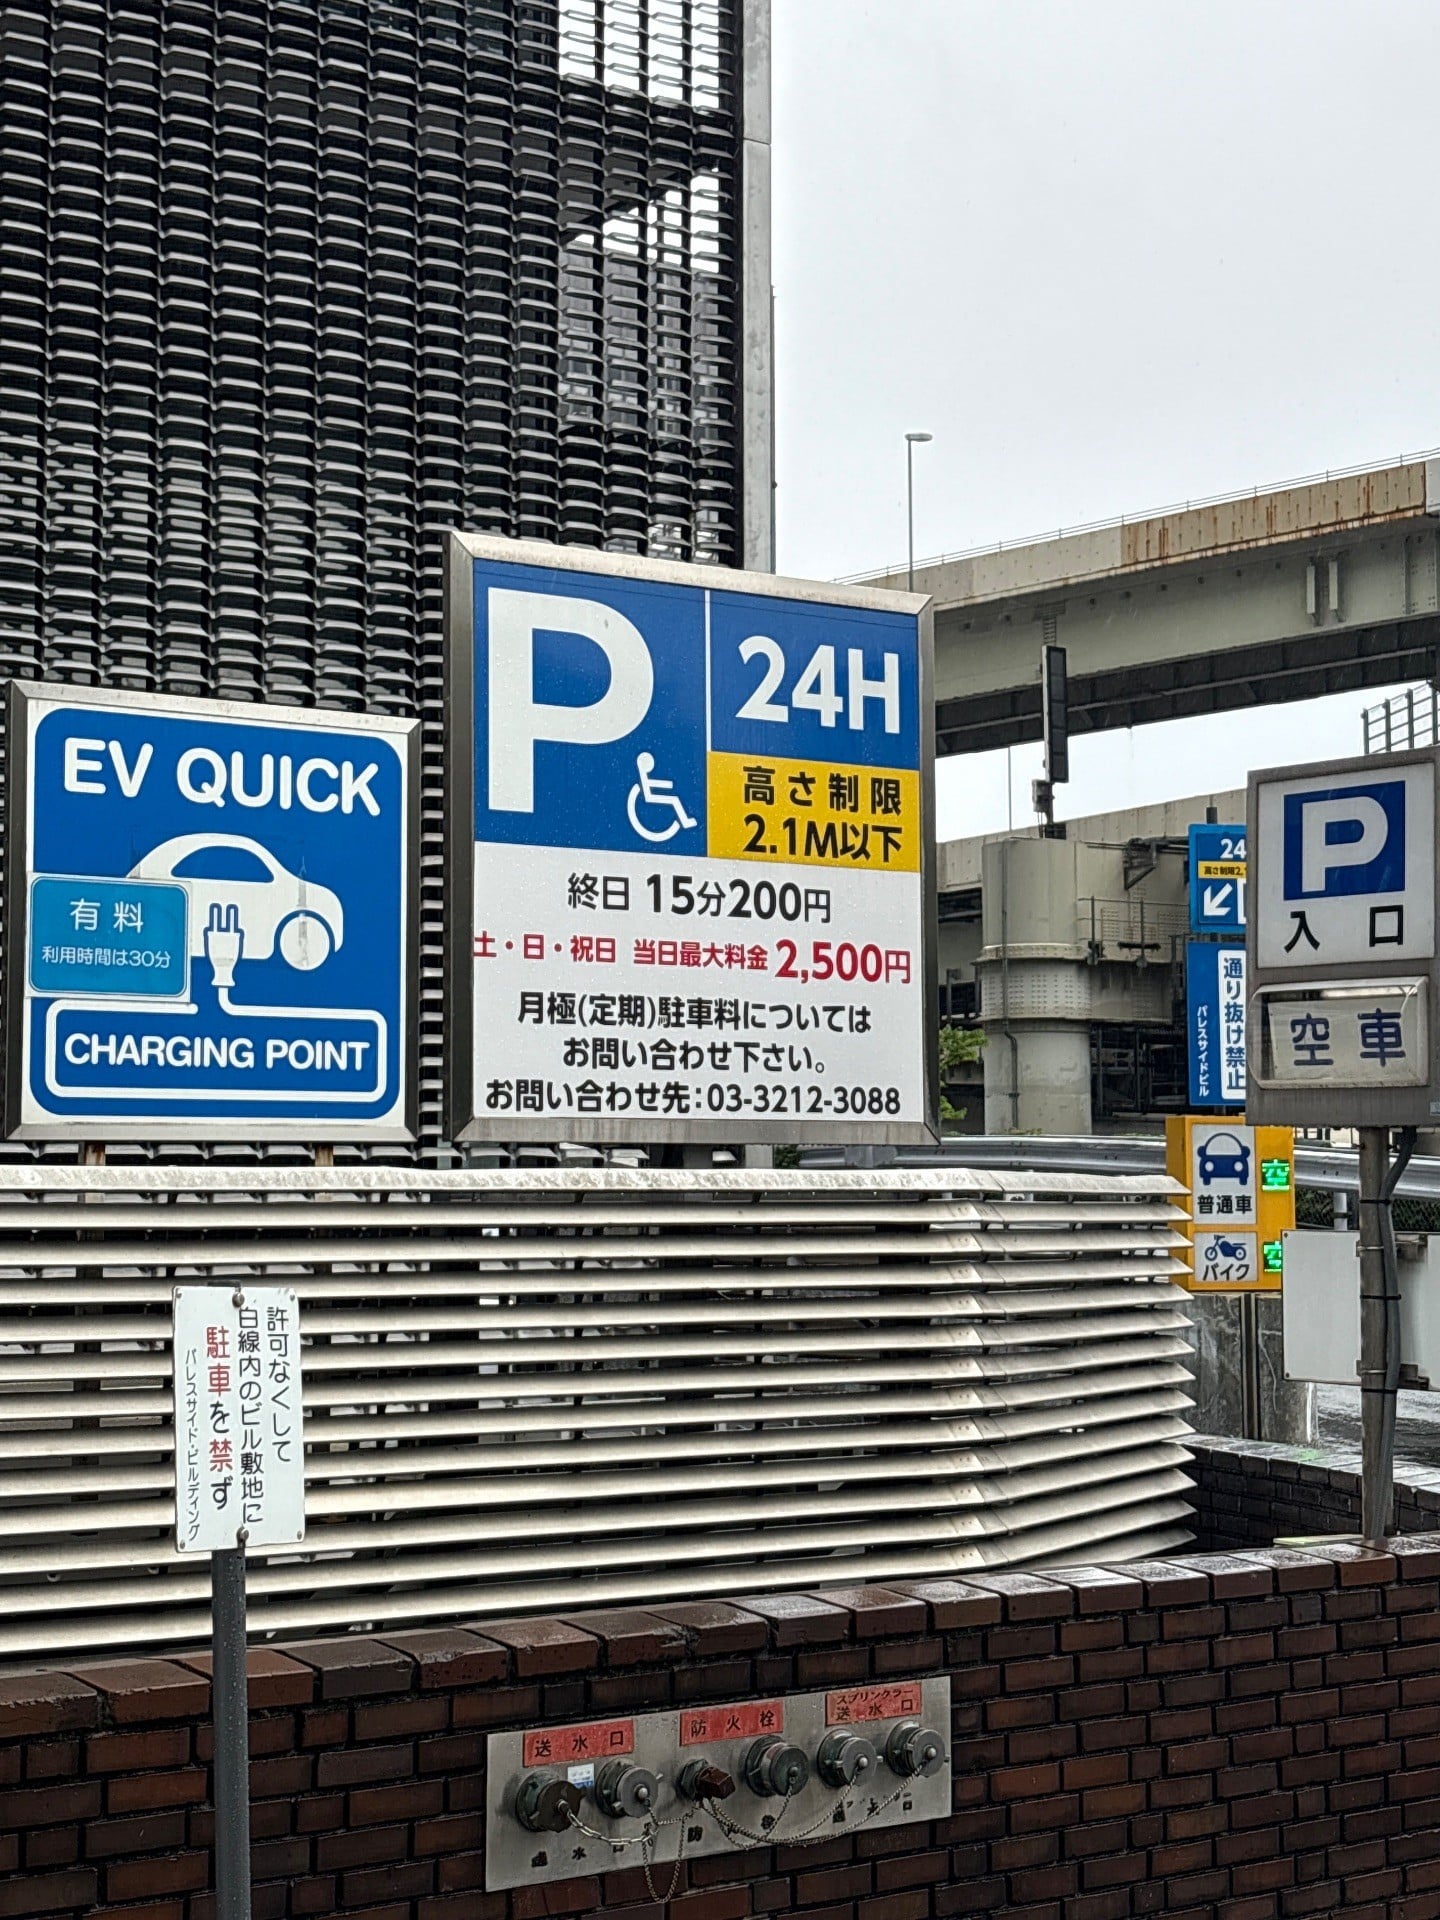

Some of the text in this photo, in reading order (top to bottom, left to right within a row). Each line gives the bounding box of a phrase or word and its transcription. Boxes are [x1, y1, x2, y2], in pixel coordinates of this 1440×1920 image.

[488, 587, 654, 813] P
[735, 635, 900, 734] 24H
[64, 737, 381, 817] EV QUICK
[743, 765, 902, 816] 高さ制限
[743, 813, 903, 863] 2.1M以下
[1302, 796, 1389, 893] P
[1204, 866, 1247, 876] 高さ制限2.
[69, 898, 144, 934] 有料
[567, 873, 831, 924] 終日 15分200円
[474, 930, 617, 964] 土・日・祝日
[1284, 905, 1404, 953] 入口
[41, 945, 171, 969] 利用時間は30分
[518, 991, 871, 1033] 月極(定期)駐車料については
[1223, 957, 1247, 1090] 通り抜け禁止
[64, 1032, 370, 1071] CHARGING POINT
[563, 1037, 826, 1075] お問い合わせ下さい。
[1197, 1004, 1210, 1097] パレスサイドビル
[1291, 1008, 1406, 1067] 空車
[1262, 1159, 1290, 1191] 空
[1197, 1194, 1253, 1215] 普通車
[1202, 1263, 1250, 1281] バイク
[266, 1306, 291, 1462] 許可なくして
[206, 1325, 234, 1510] 駐車を禁ず
[237, 1307, 264, 1524] 白線内のビル敷地に
[836, 1699, 913, 1721] 送水口
[837, 1689, 913, 1704] スプリンクラー
[535, 1731, 624, 1757] 送水口
[690, 1709, 776, 1738] 防火栓
